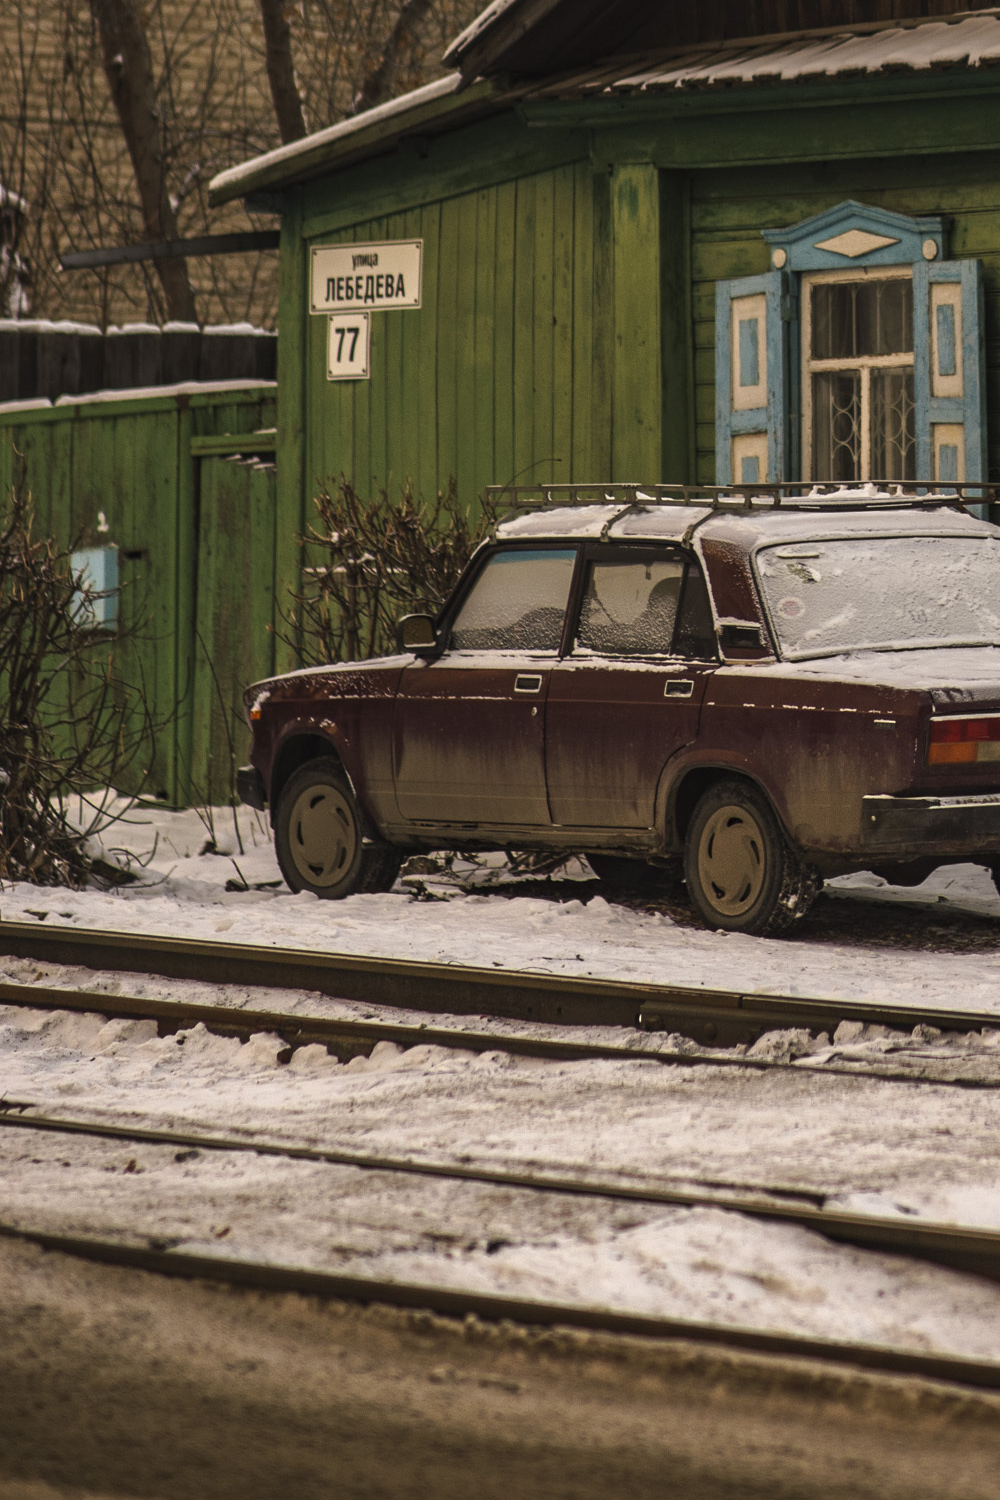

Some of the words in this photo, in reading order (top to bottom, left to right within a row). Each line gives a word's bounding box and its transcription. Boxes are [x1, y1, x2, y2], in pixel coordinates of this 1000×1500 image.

[352, 253, 378, 270] улица
[325, 273, 405, 304] ЛЕБЕДЕВА
[335, 327, 359, 362] 77
